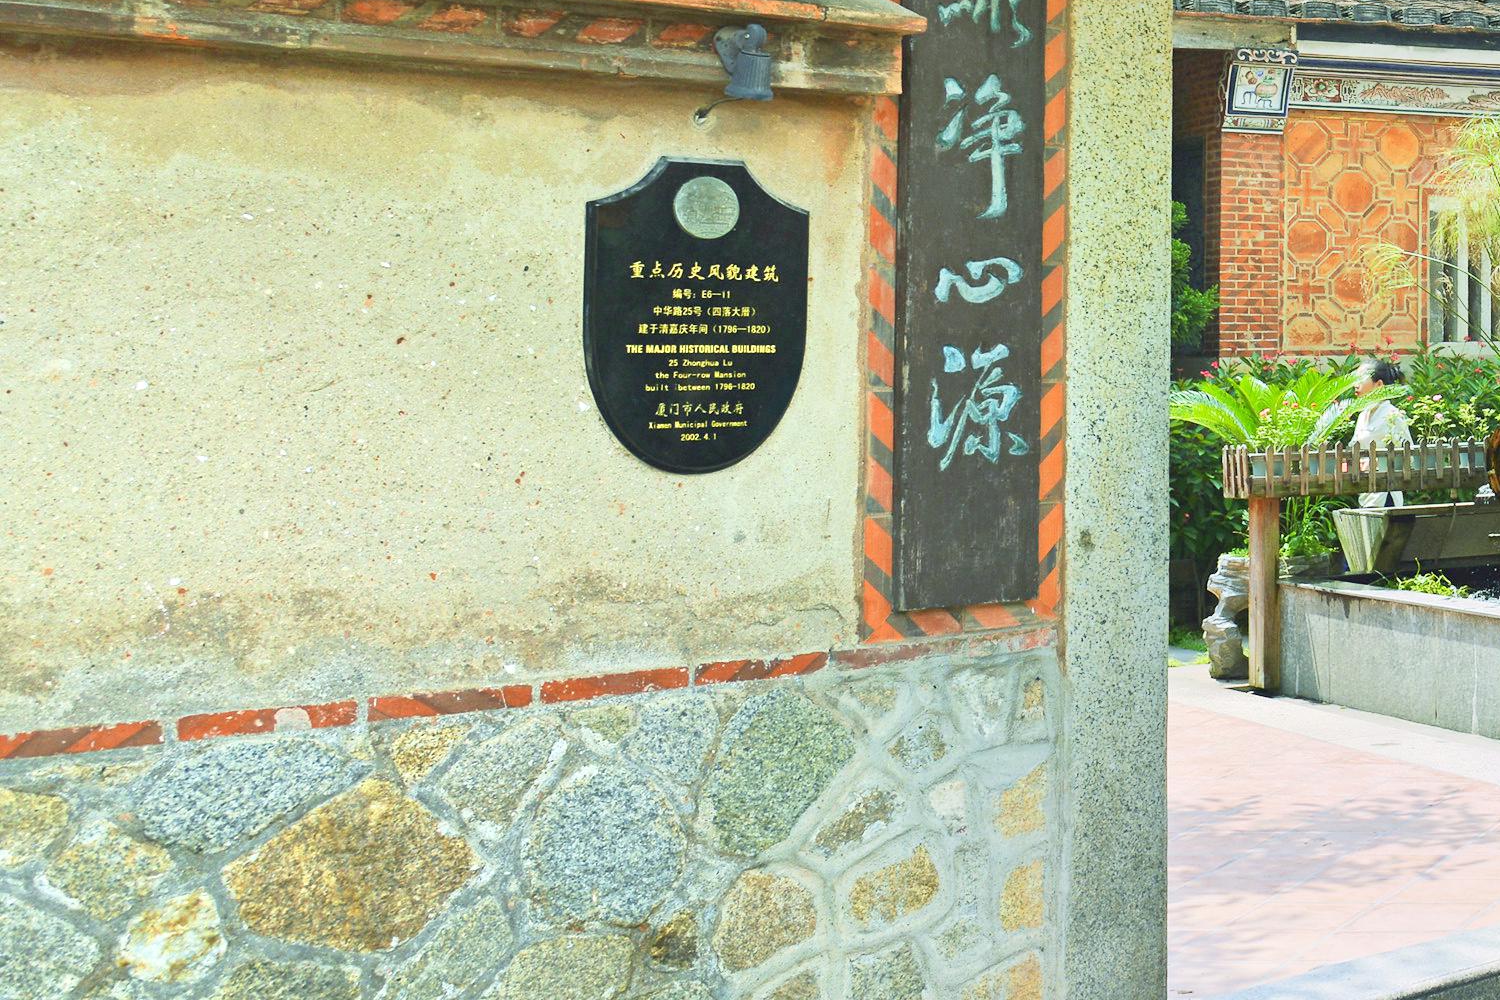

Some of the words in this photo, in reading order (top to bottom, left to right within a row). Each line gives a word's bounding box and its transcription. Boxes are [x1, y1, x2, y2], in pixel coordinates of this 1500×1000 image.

[629, 260, 779, 283] 重点历史风貌建筑
[625, 344, 643, 354] THE
[645, 344, 678, 354] MAJOR
[679, 344, 730, 354] HISTORICAL
[731, 344, 777, 354] BUILDINGS
[668, 358, 679, 367] 25
[682, 358, 720, 368] Zhonghua
[722, 359, 733, 367] Lu
[654, 371, 670, 379] the
[672, 370, 711, 379] Four-row
[713, 370, 747, 379] Mansion
[644, 383, 669, 392] built
[677, 383, 711, 392] between
[715, 382, 756, 391] 1796-1820
[655, 401, 744, 418] 厦门市人民政府
[648, 421, 673, 430] Xiamen
[674, 420, 708, 429] Municipal
[710, 419, 748, 428] Government
